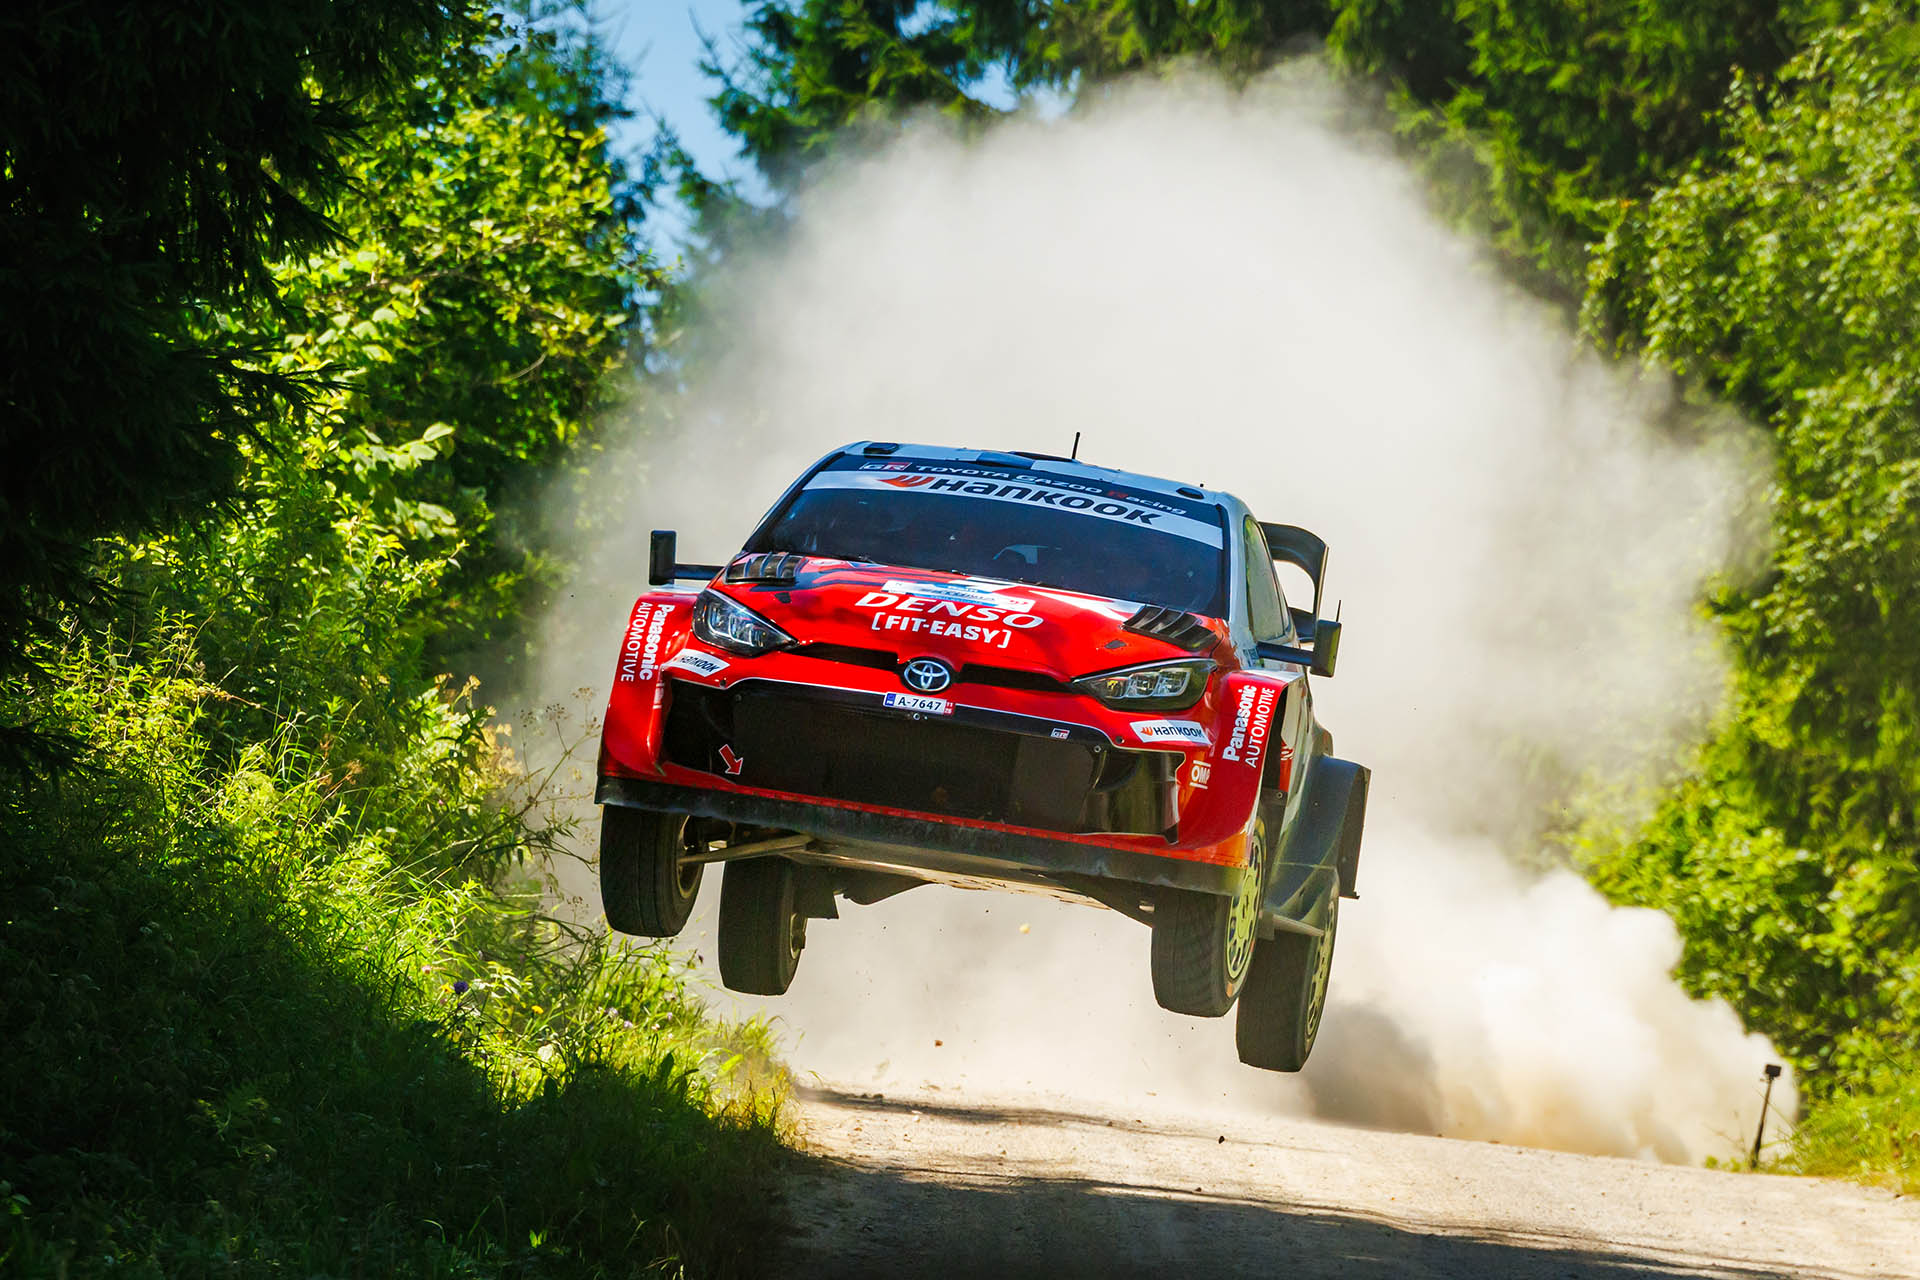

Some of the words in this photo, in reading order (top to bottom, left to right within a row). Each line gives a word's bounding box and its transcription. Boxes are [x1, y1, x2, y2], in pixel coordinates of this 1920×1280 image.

[916, 465, 1009, 478] TOYOTA
[1015, 474, 1102, 494] GAZOO
[1107, 490, 1187, 514] Racing
[620, 601, 651, 682] AUTOMOTIVE
[640, 604, 675, 681] Panasonic
[855, 592, 1044, 628] DENSO
[898, 696, 941, 710] A-7647
[1222, 684, 1257, 762] Panasonic
[1244, 687, 1275, 768] AUTOMOTIVE
